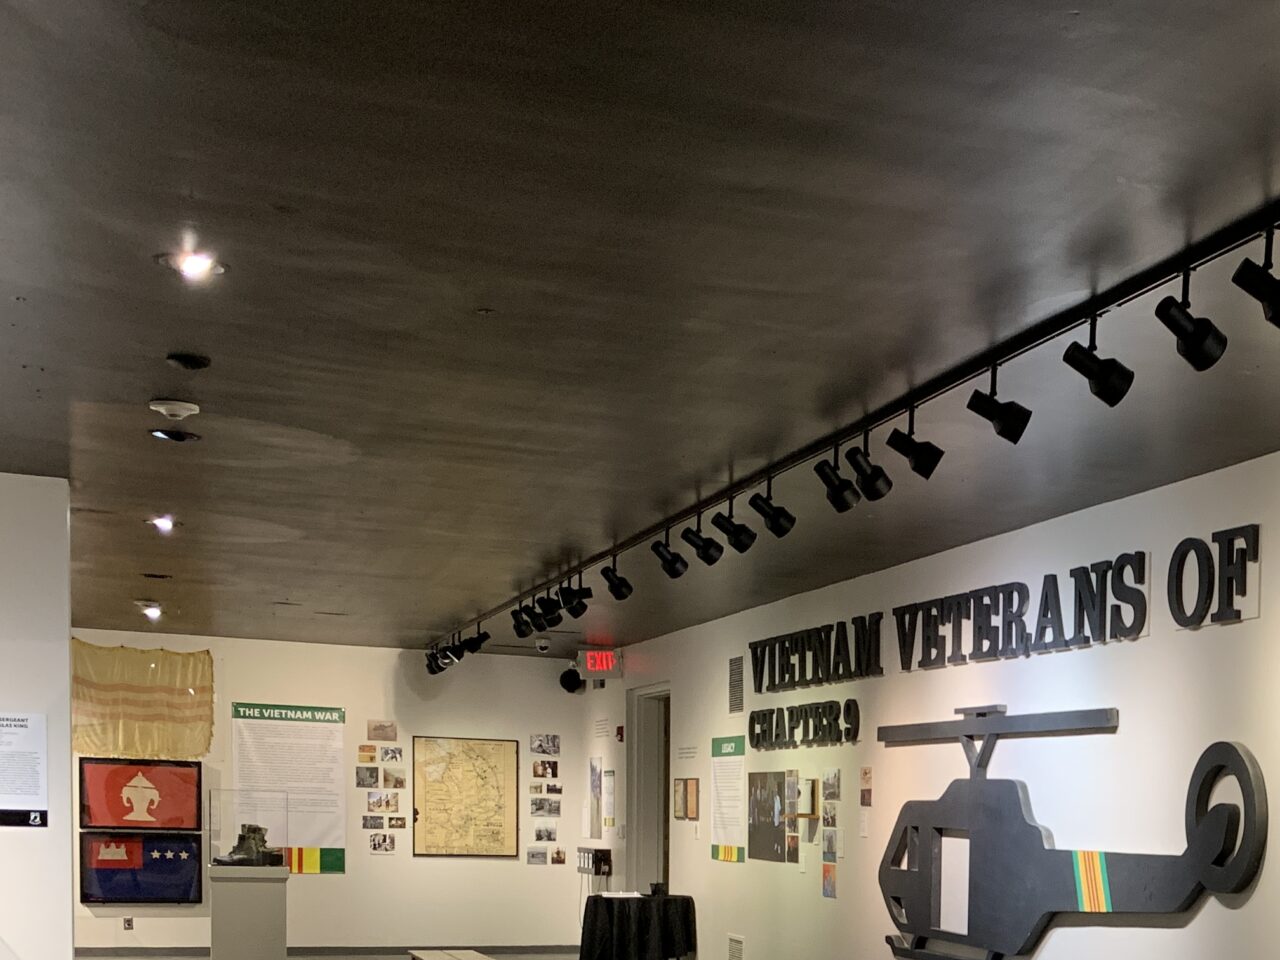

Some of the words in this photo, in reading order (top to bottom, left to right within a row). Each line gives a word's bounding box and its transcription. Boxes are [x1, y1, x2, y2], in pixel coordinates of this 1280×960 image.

[748, 611, 884, 693] VIETNAM
[893, 551, 1147, 672] VETERANS
[1167, 524, 1259, 628] OF
[586, 650, 616, 671] EXIT
[238, 707, 260, 717] THE
[263, 709, 312, 719] VIETNAM
[315, 712, 339, 721] WAR
[748, 701, 842, 749] CHAPTER
[843, 698, 861, 742] 9
